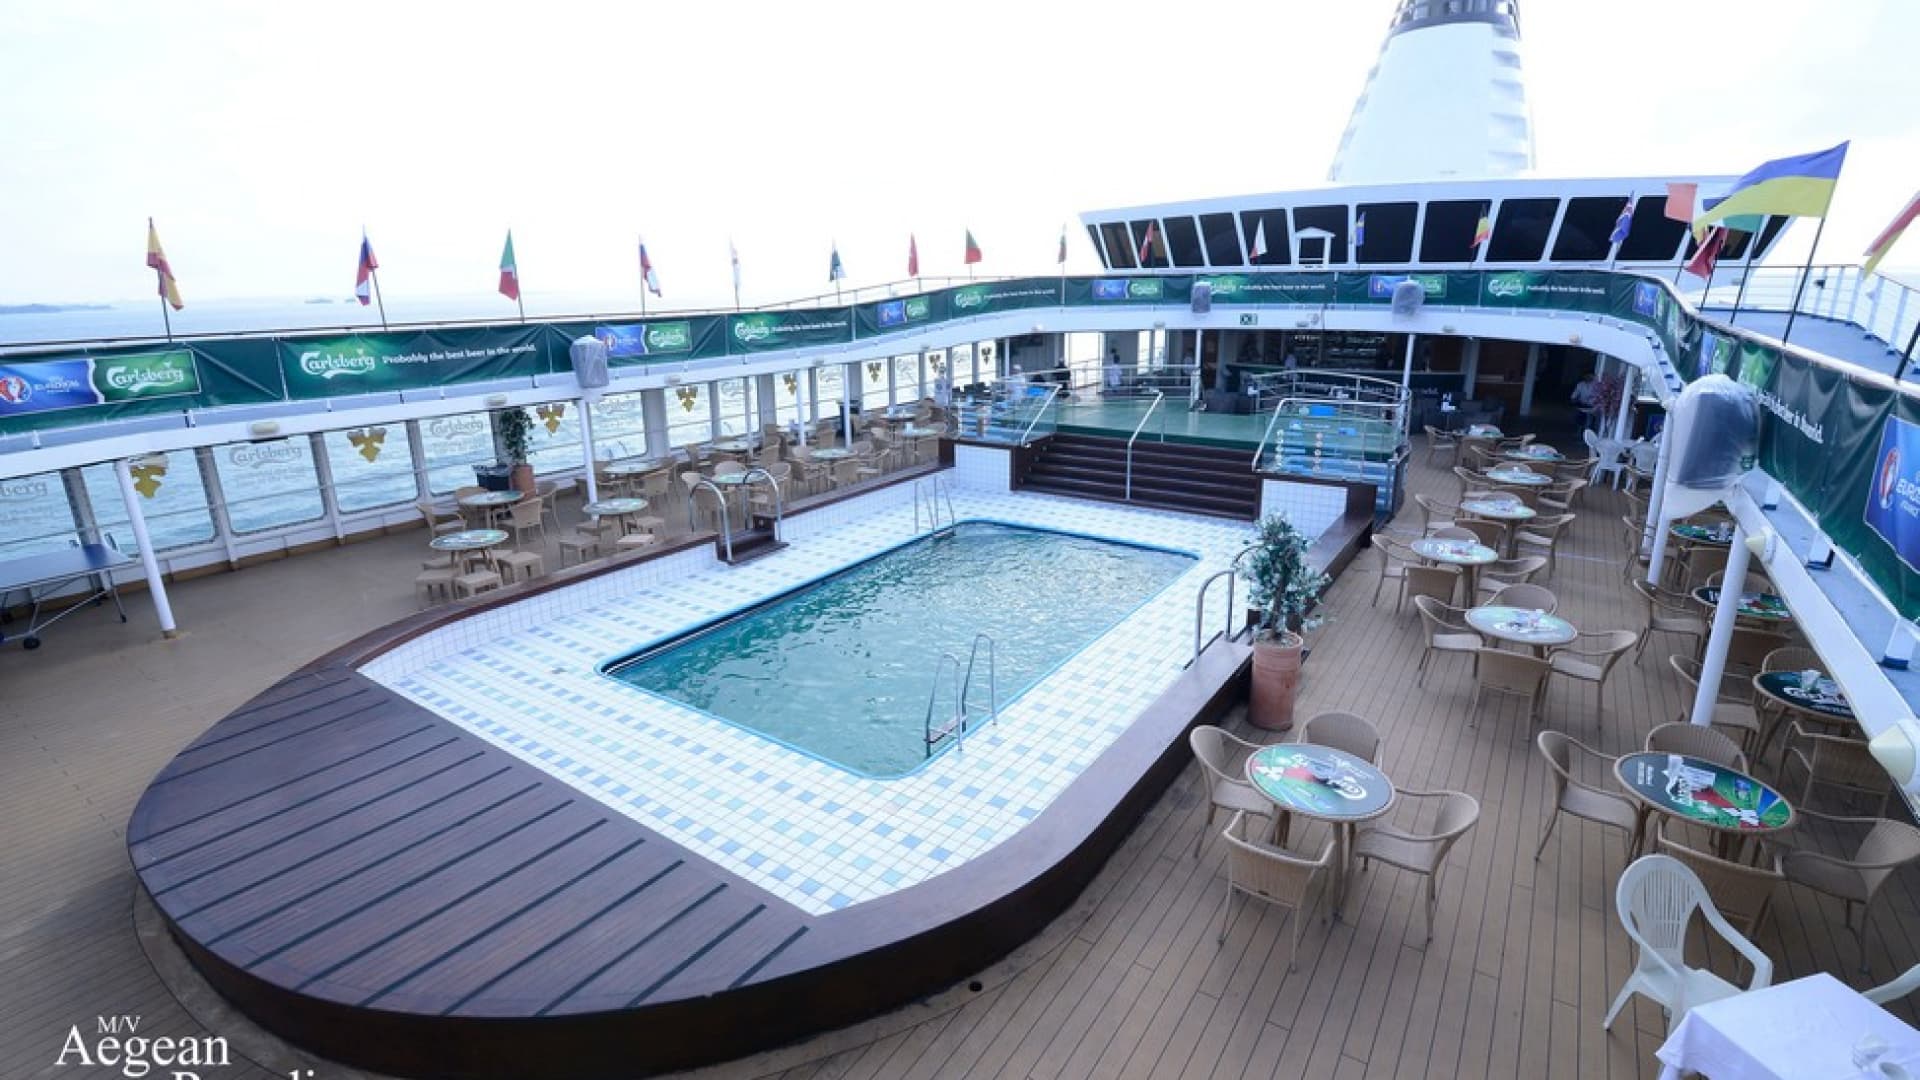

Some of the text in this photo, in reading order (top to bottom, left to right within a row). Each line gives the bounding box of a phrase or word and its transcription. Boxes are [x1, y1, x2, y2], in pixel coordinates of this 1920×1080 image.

[301, 351, 376, 379] Carlsberg
[382, 352, 429, 364] Probably
[430, 352, 445, 360] the
[106, 364, 184, 392] Carlsberg
